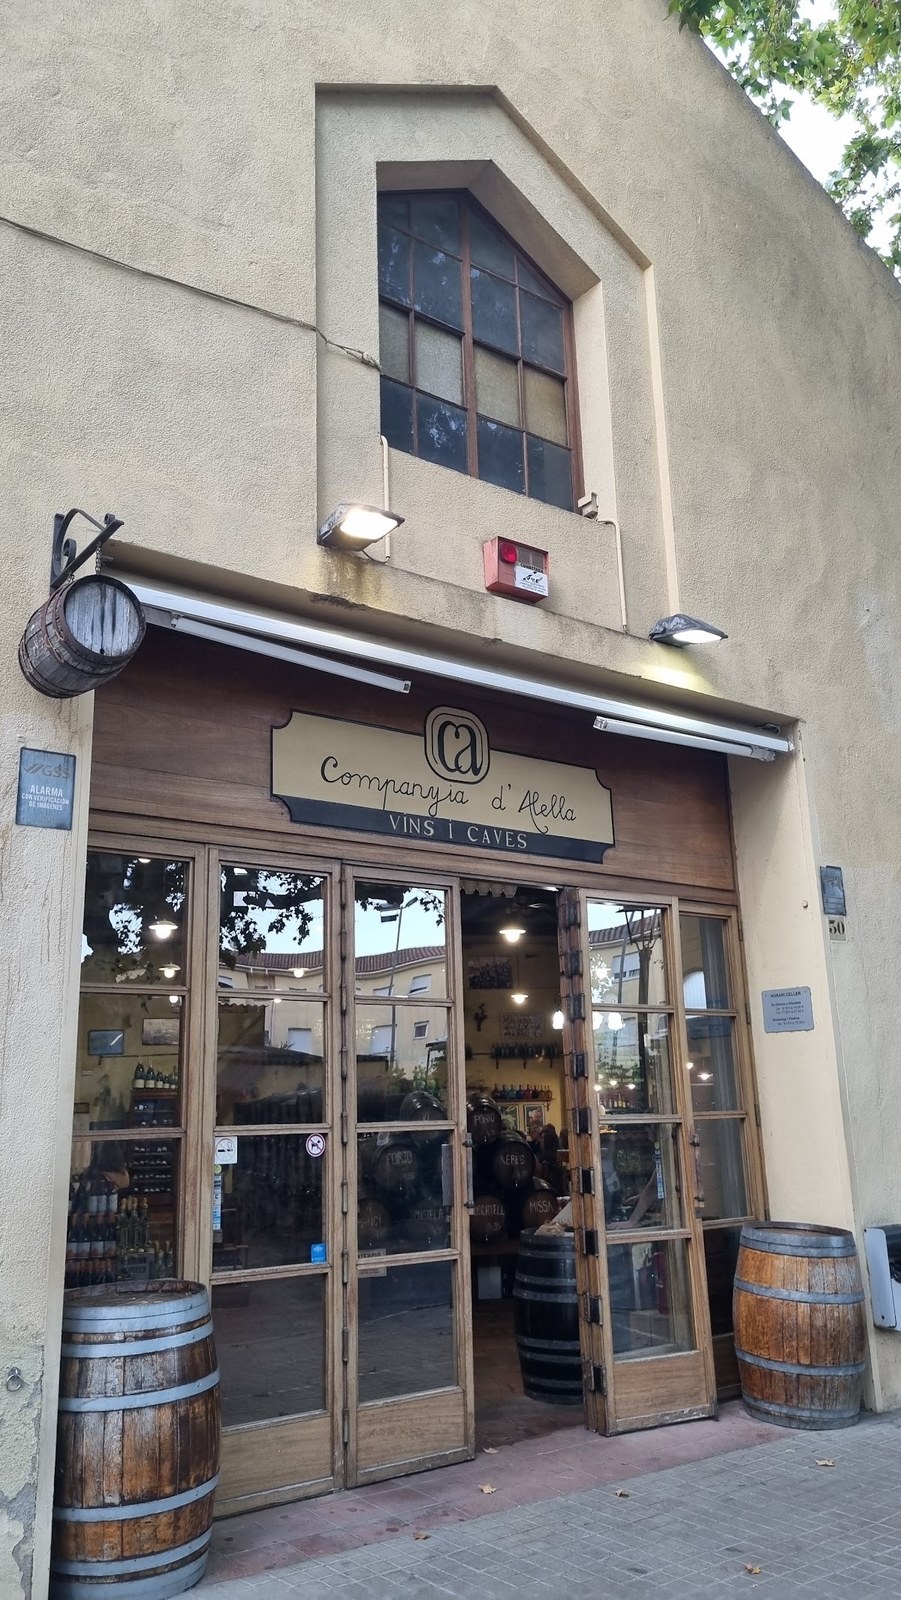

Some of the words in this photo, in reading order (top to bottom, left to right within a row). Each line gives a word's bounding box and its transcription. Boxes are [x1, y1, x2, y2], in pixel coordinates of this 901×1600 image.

[30, 785, 63, 798] ALARMA
[320, 756, 469, 817] Companyia
[21, 792, 33, 800] CON
[389, 813, 435, 837] VINS
[467, 826, 528, 849] CAVES
[829, 919, 846, 935] 50
[529, 1200, 554, 1214] MISSA
